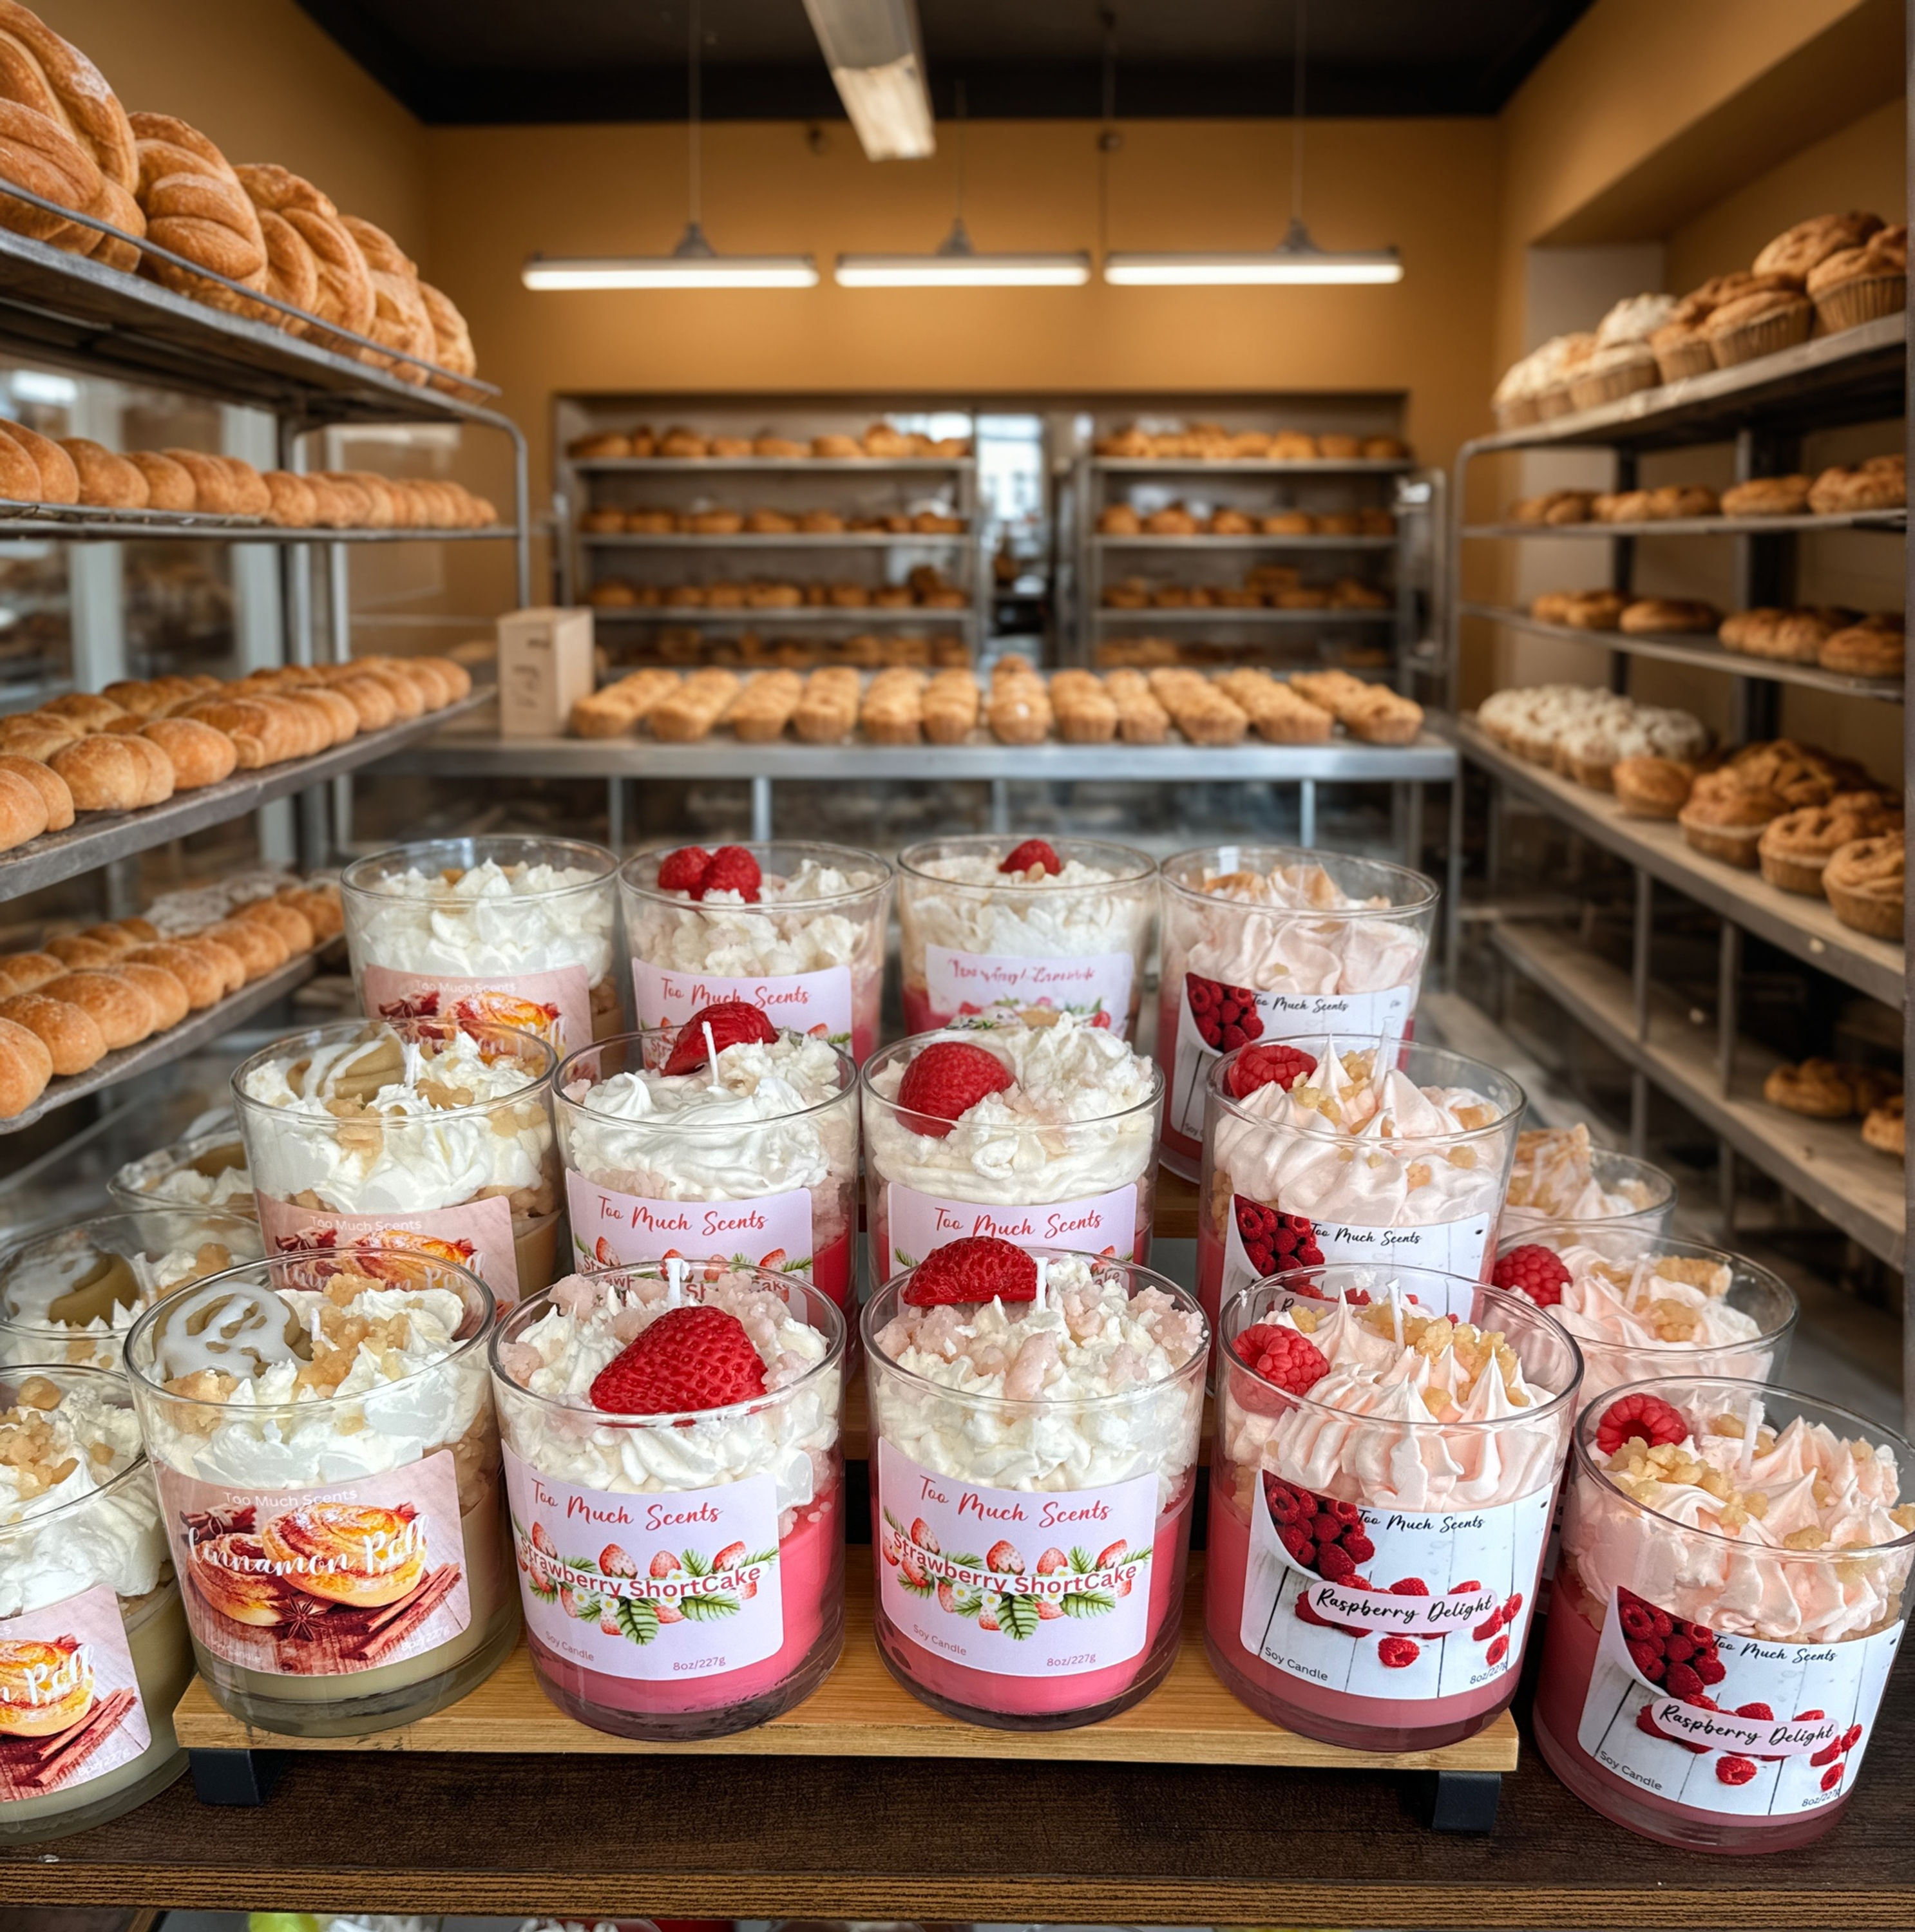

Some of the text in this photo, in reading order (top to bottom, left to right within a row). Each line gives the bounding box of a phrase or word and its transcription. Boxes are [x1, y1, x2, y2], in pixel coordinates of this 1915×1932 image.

[416, 980, 516, 993] Too Much Scents
[661, 977, 811, 1009] Too Much Scents
[1251, 993, 1350, 1013] Too Much Scents
[309, 1215, 423, 1232] Too Much Scents
[598, 1195, 769, 1236] Too Much Scents
[934, 1207, 1105, 1239] Too Much Scents
[1310, 1223, 1423, 1246] Too Much Scents
[224, 1489, 358, 1508] Too Much Scents
[531, 1478, 724, 1531] Too Much Scents
[920, 1475, 1113, 1528] Too Much Scents
[1357, 1508, 1486, 1533] Too Much Scents
[187, 1514, 430, 1577] Cinnamon Roll
[520, 1535, 761, 1598] Strawberry ShortCake
[893, 1530, 1137, 1595] Strawberry ShortCake
[1316, 1587, 1493, 1625] Raspberry Delight
[545, 1631, 595, 1662] Soy Candle
[913, 1624, 967, 1656] Soy Candle
[1712, 1634, 1838, 1664] Too Much Scents
[23, 1643, 96, 1705] Roll
[672, 1654, 726, 1671] 8oz/227g
[1046, 1653, 1096, 1668] 8oz/227g
[1264, 1647, 1328, 1681] Soy Candle
[1659, 1705, 1834, 1746] Raspberry Delight
[1598, 1750, 1663, 1791] Soy Candle
